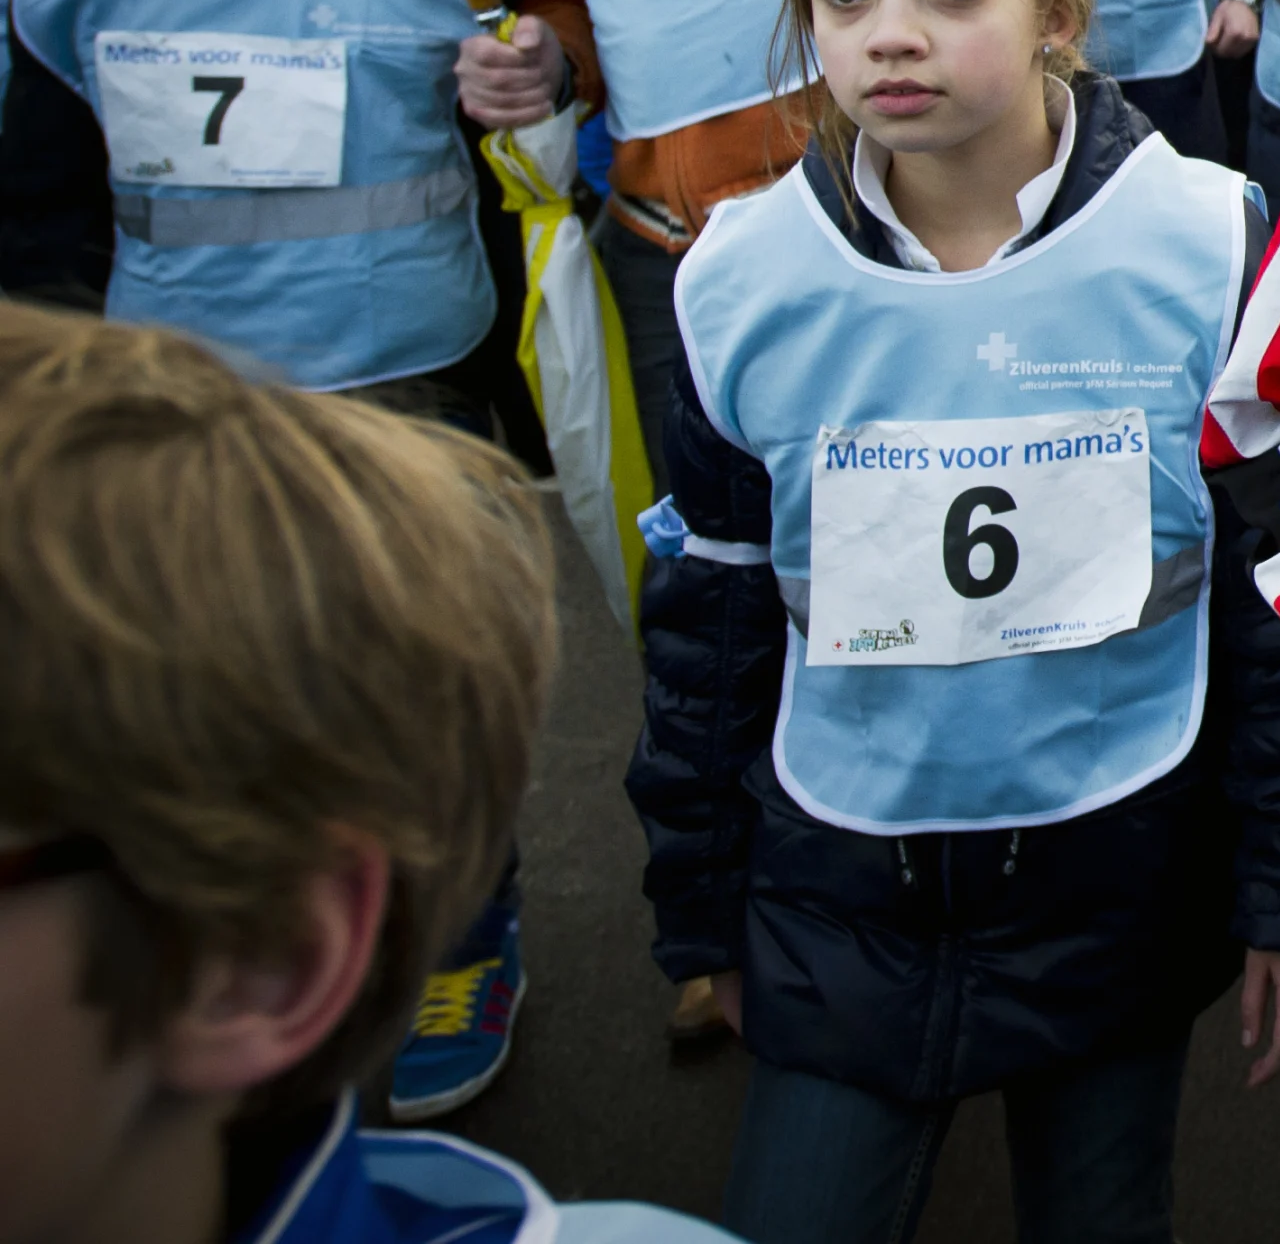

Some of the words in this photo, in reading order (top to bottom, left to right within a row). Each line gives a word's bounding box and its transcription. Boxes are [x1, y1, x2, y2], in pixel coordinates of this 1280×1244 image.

[104, 43, 181, 65] Meters
[187, 49, 242, 65] voor
[250, 49, 342, 70] mama's
[192, 76, 245, 145] 7
[1009, 359, 1123, 376] ZilverenKruis
[1051, 380, 1084, 390] partner
[826, 440, 929, 470] Meters
[939, 444, 1013, 470] voor
[1025, 424, 1144, 464] mama's
[943, 485, 1019, 599] 6
[1001, 619, 1086, 640] ZilverenKruis
